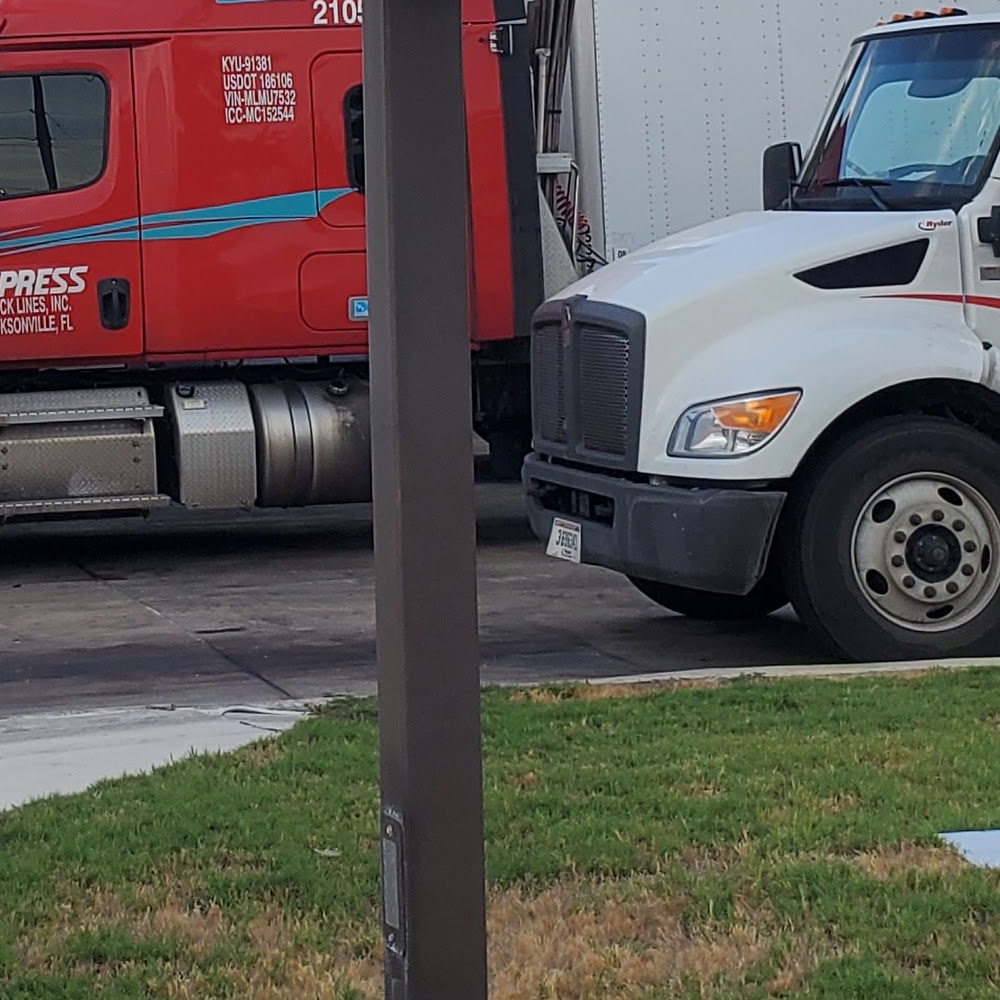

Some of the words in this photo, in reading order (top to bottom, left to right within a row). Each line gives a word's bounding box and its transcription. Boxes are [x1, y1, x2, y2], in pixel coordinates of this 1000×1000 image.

[221, 55, 272, 73] KYU-91381
[222, 73, 257, 90] USDOT
[260, 72, 293, 89] 186106
[224, 89, 296, 107] VIN-MLMU7532
[225, 105, 295, 124] ICC-MC152544
[925, 219, 954, 231] Ryder
[16, 296, 49, 315] LINES,
[50, 294, 72, 312] INC.
[60, 314, 74, 331] FL
